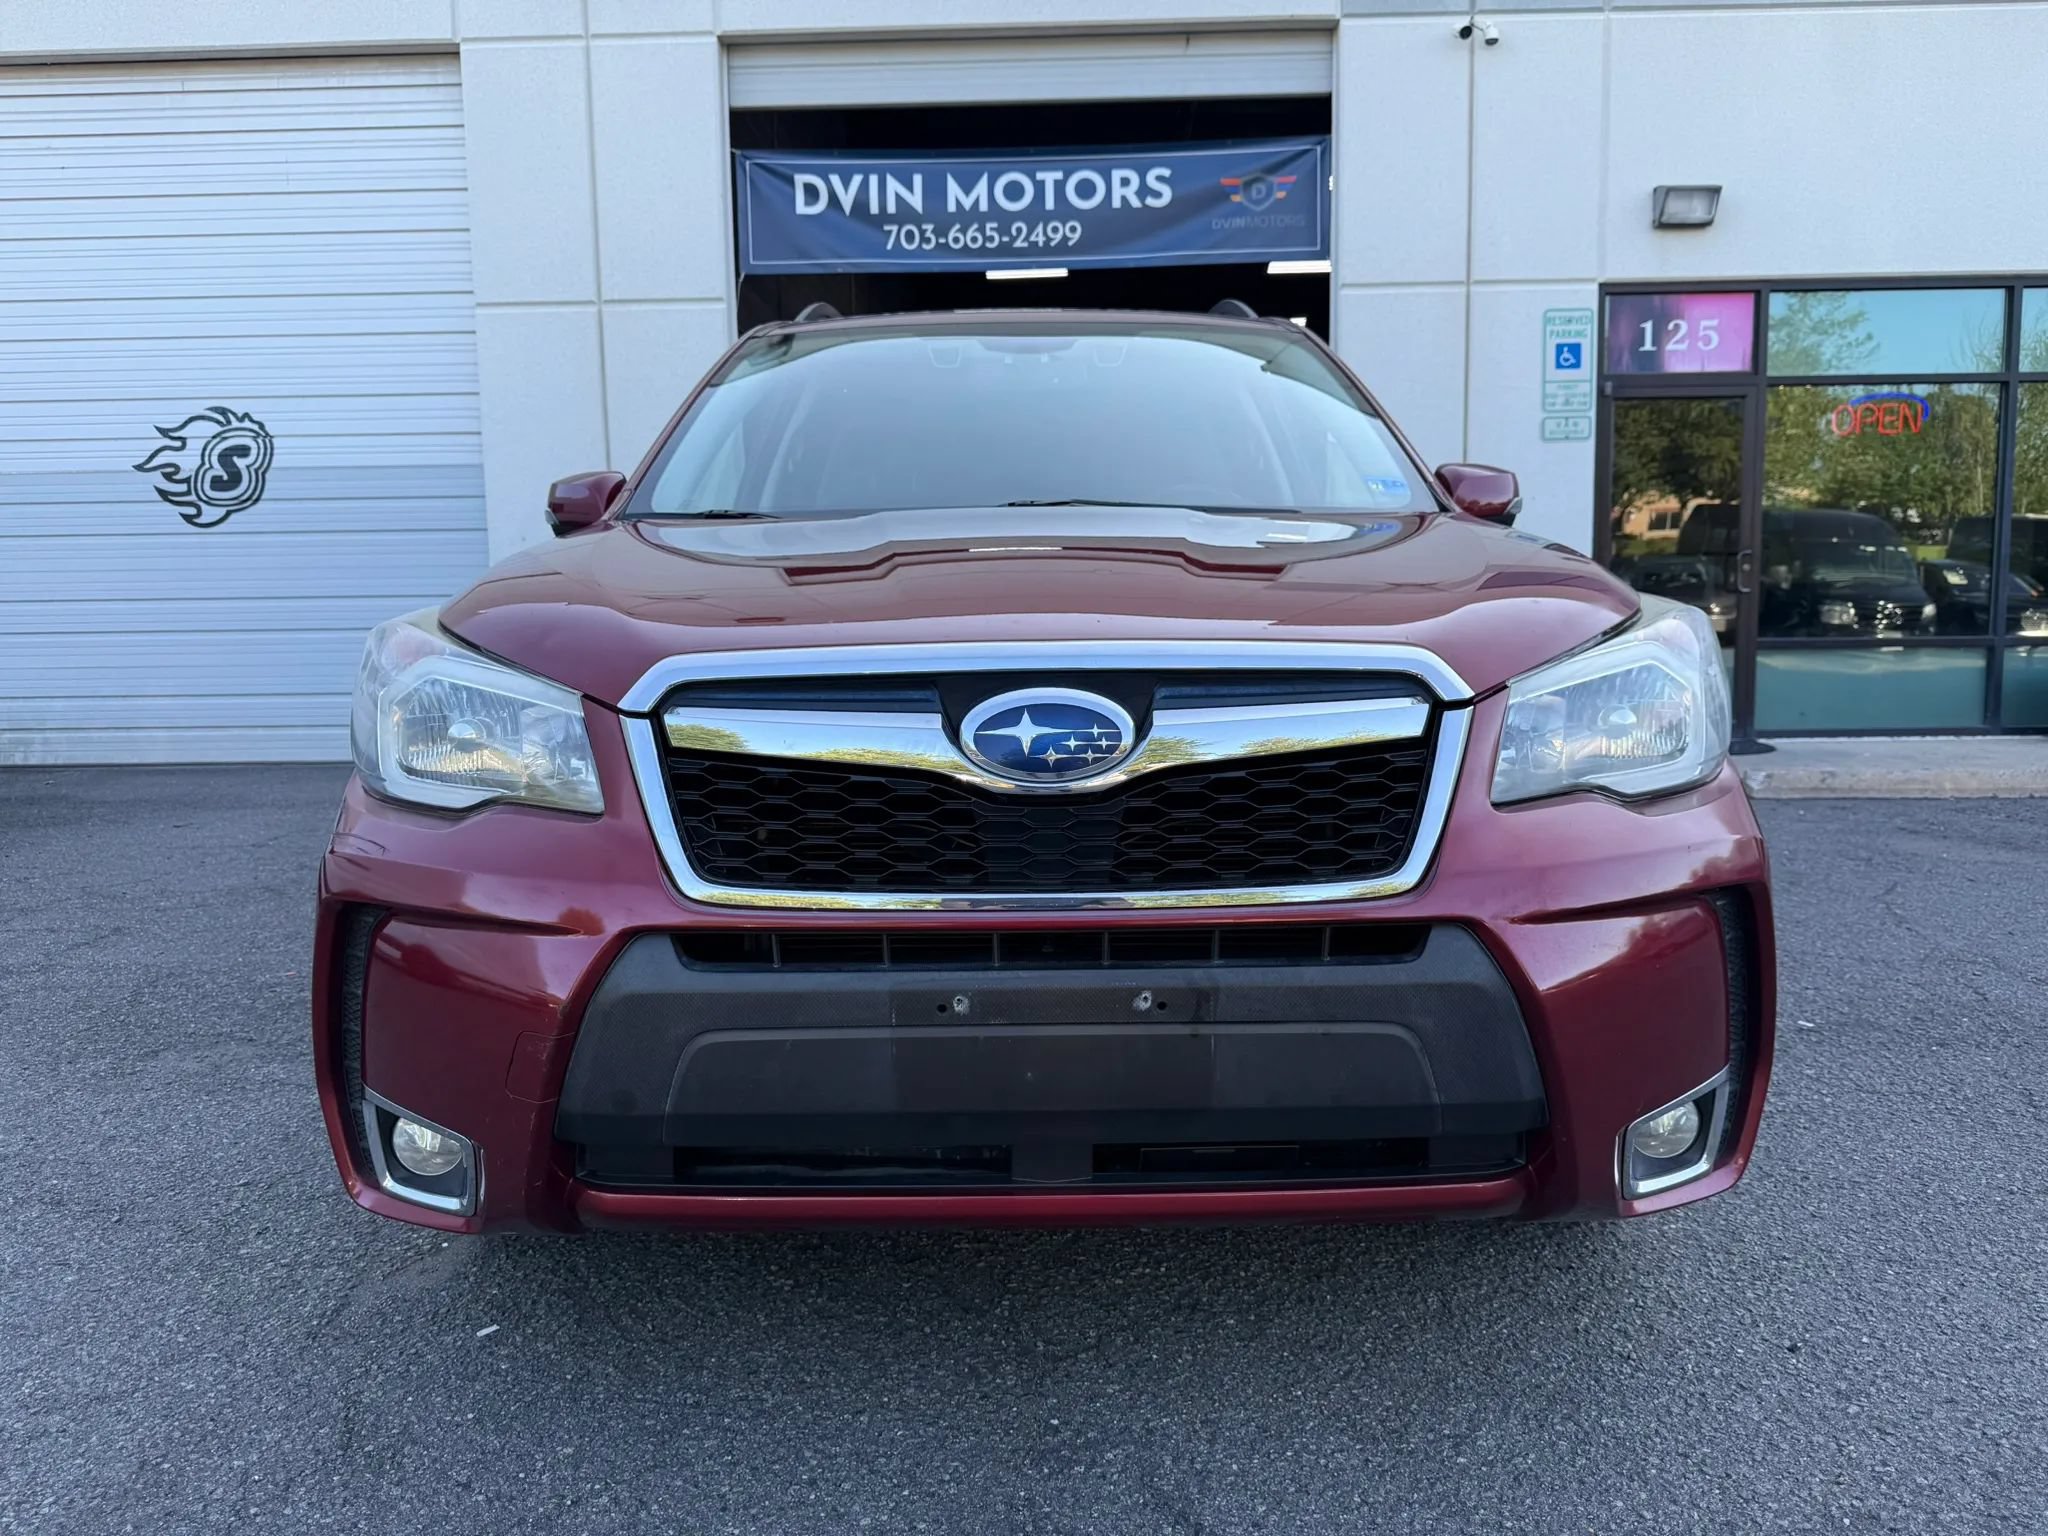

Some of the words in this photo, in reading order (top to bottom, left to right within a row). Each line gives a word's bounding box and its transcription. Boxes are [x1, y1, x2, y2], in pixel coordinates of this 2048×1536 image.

[793, 172, 923, 216] DVIN
[946, 167, 1173, 213] MOTORS
[883, 220, 1082, 250] 703-665-2499
[1638, 319, 1720, 352] 125
[1831, 403, 1923, 436] OPEN
